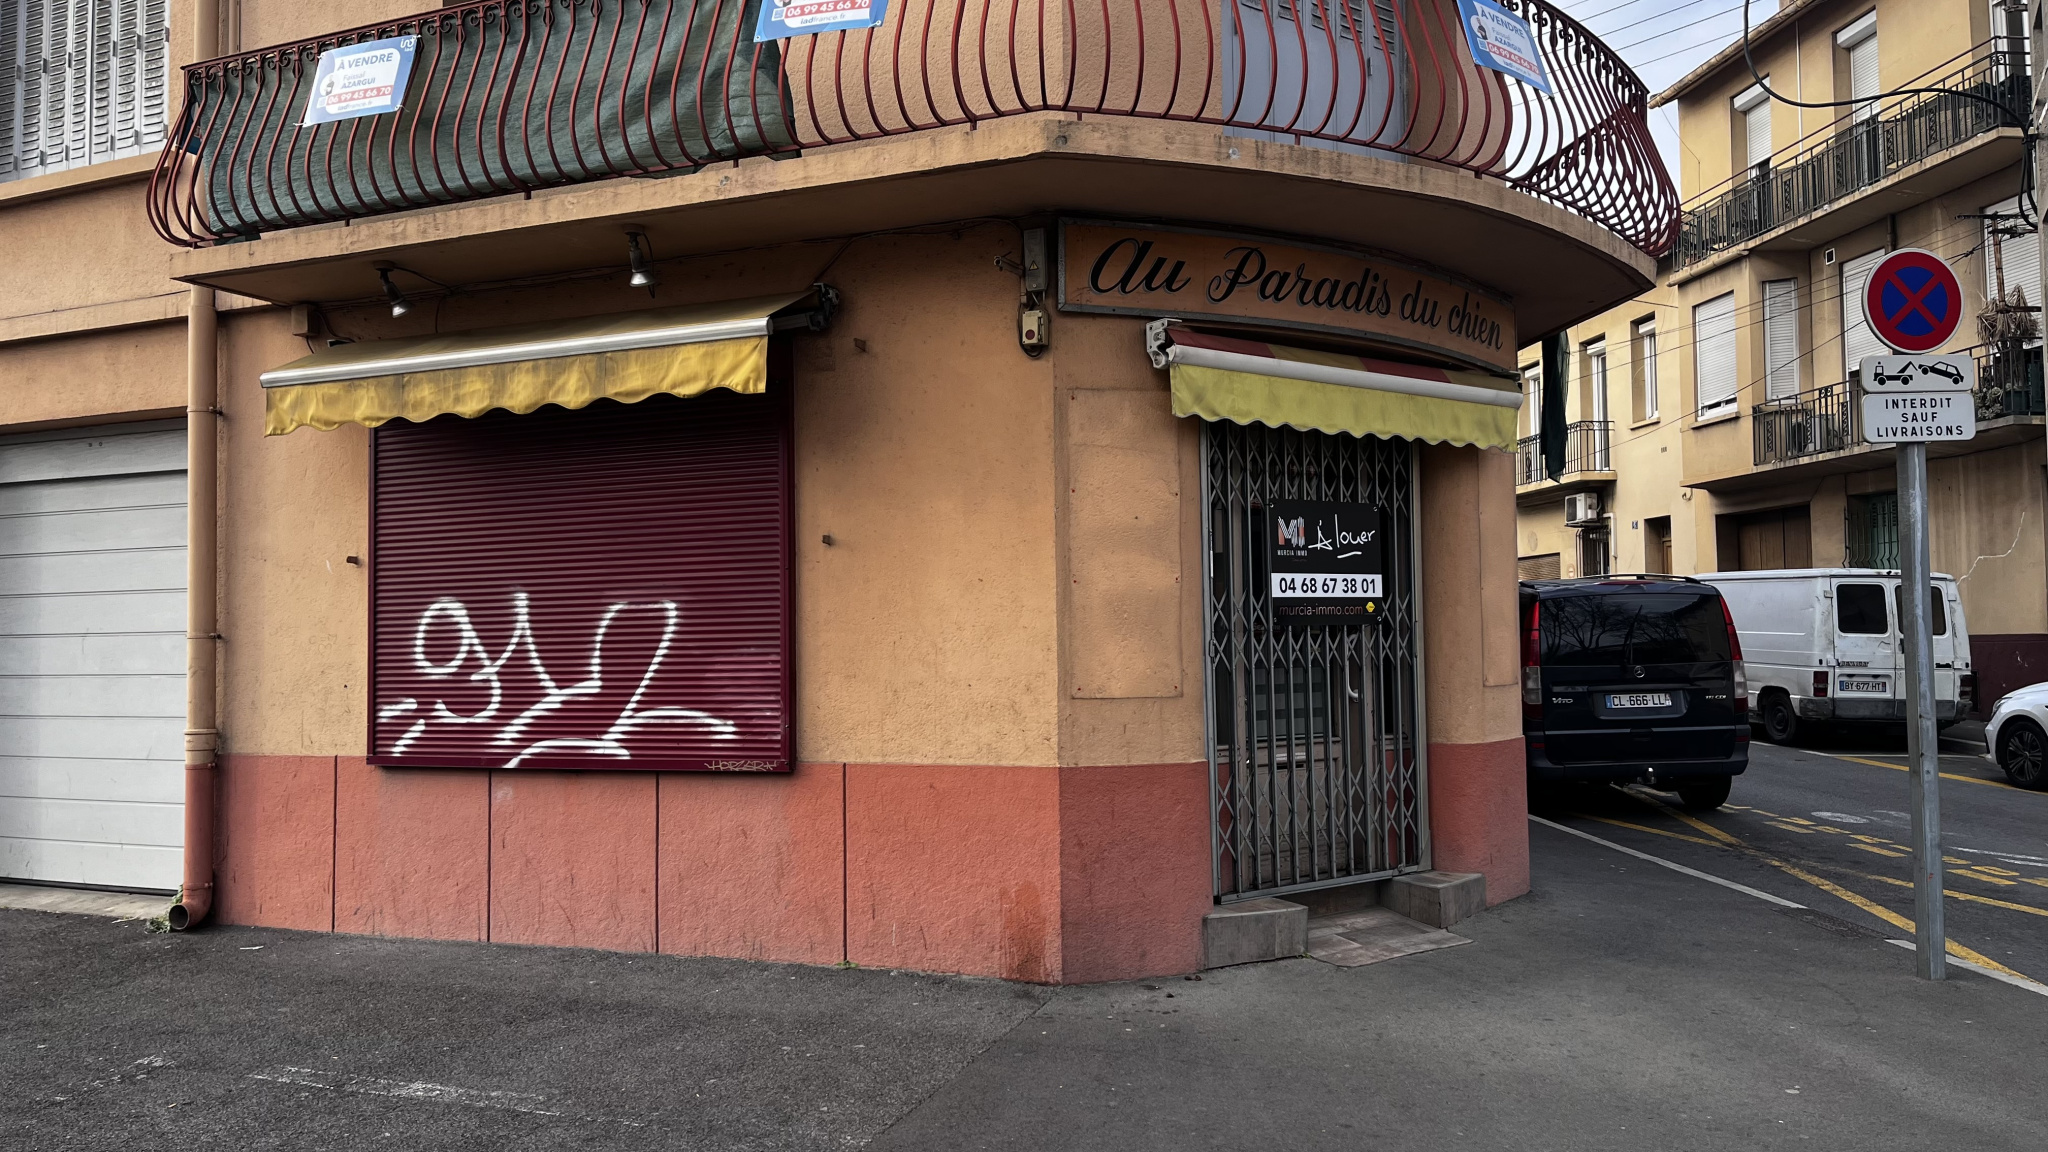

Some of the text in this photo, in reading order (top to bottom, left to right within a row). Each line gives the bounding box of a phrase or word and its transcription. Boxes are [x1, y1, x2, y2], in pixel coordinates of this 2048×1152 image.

[787, 0, 870, 17] 06 99 45 66 70
[1488, 11, 1525, 39] VENDRE
[1488, 43, 1500, 54] 06
[1500, 48, 1511, 59] 99
[337, 52, 394, 72] À VENDRE
[341, 77, 376, 90] AZARGUI
[327, 86, 392, 105] 06 99 45 66 70
[1206, 246, 1392, 318] Paradis
[1399, 280, 1443, 329] du
[1446, 291, 1505, 352] chien
[1885, 397, 1952, 410] INTERDIT
[1901, 412, 1938, 423] SAUF
[1876, 425, 1964, 438] LIVRAISONS
[1334, 513, 1376, 549] louer
[1279, 577, 1376, 594] 04 68 67 38 01
[1279, 602, 1364, 616] murcia-immo.com
